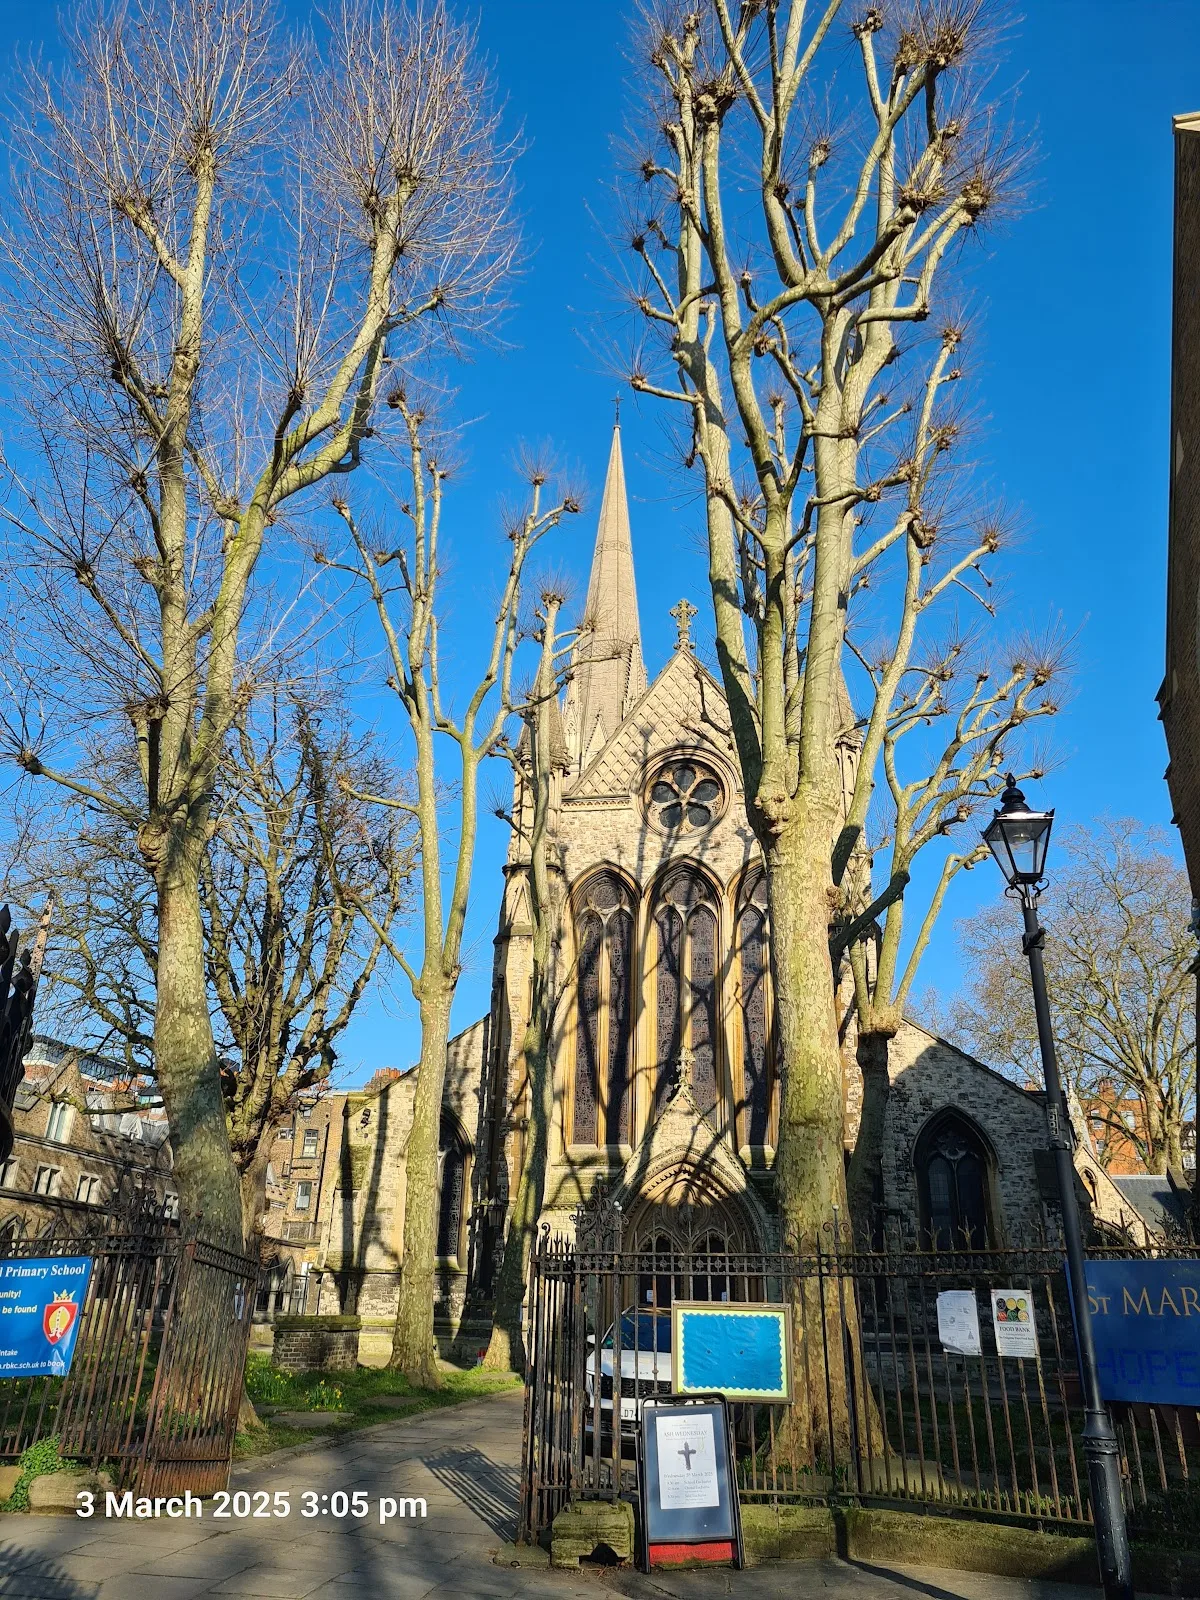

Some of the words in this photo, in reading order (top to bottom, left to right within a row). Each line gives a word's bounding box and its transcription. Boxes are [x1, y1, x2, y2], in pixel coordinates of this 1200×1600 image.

[5, 1266, 49, 1279] Primary
[51, 1264, 86, 1276] School
[2, 1305, 13, 1314] be
[14, 1304, 38, 1314] found
